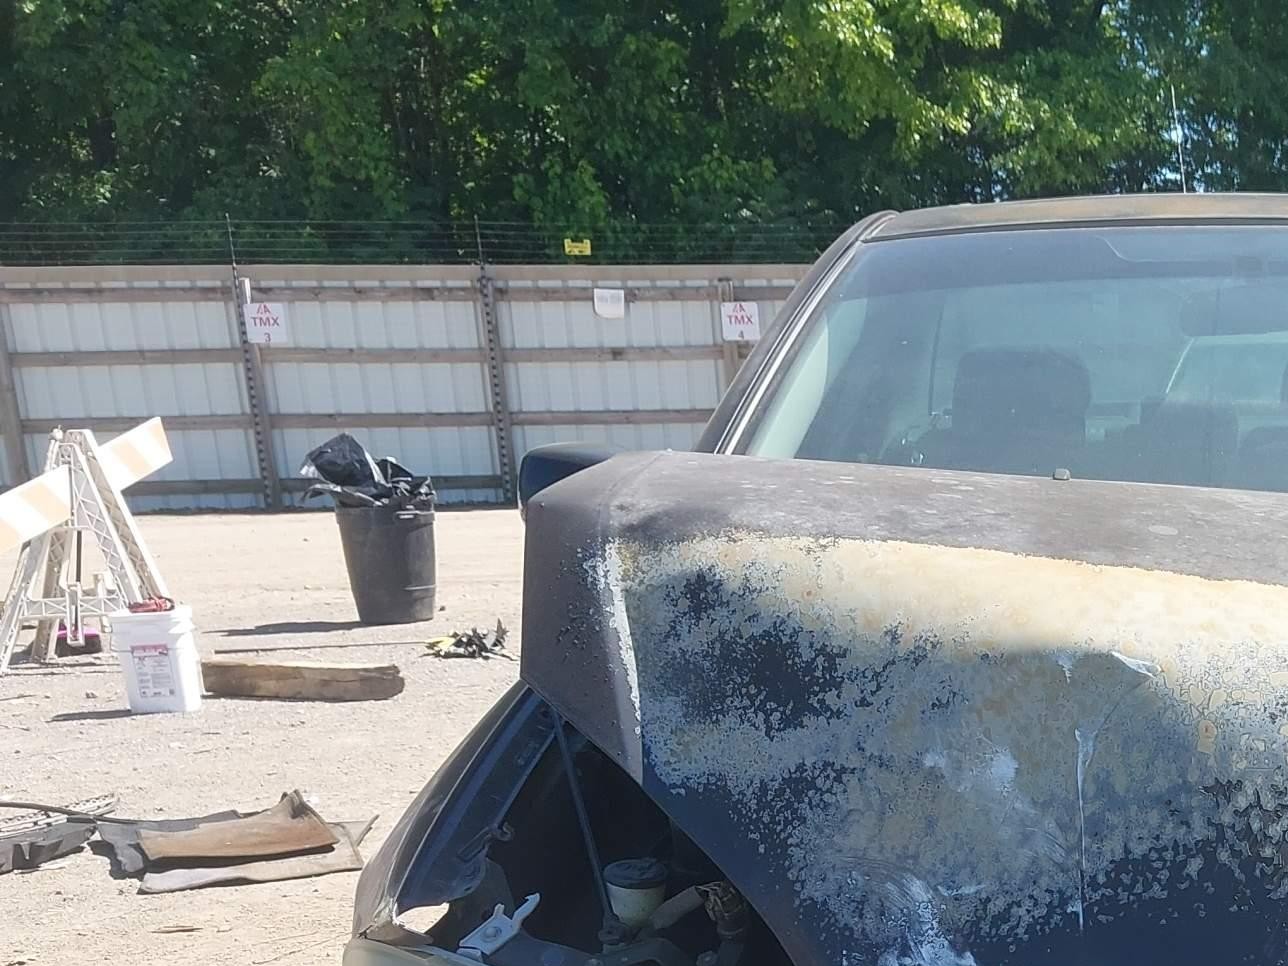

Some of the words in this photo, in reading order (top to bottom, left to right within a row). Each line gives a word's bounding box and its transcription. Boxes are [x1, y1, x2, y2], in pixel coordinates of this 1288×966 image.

[250, 316, 280, 327] TMX
[727, 314, 753, 325] TMX
[264, 332, 271, 342] 3
[738, 330, 745, 340] 4
